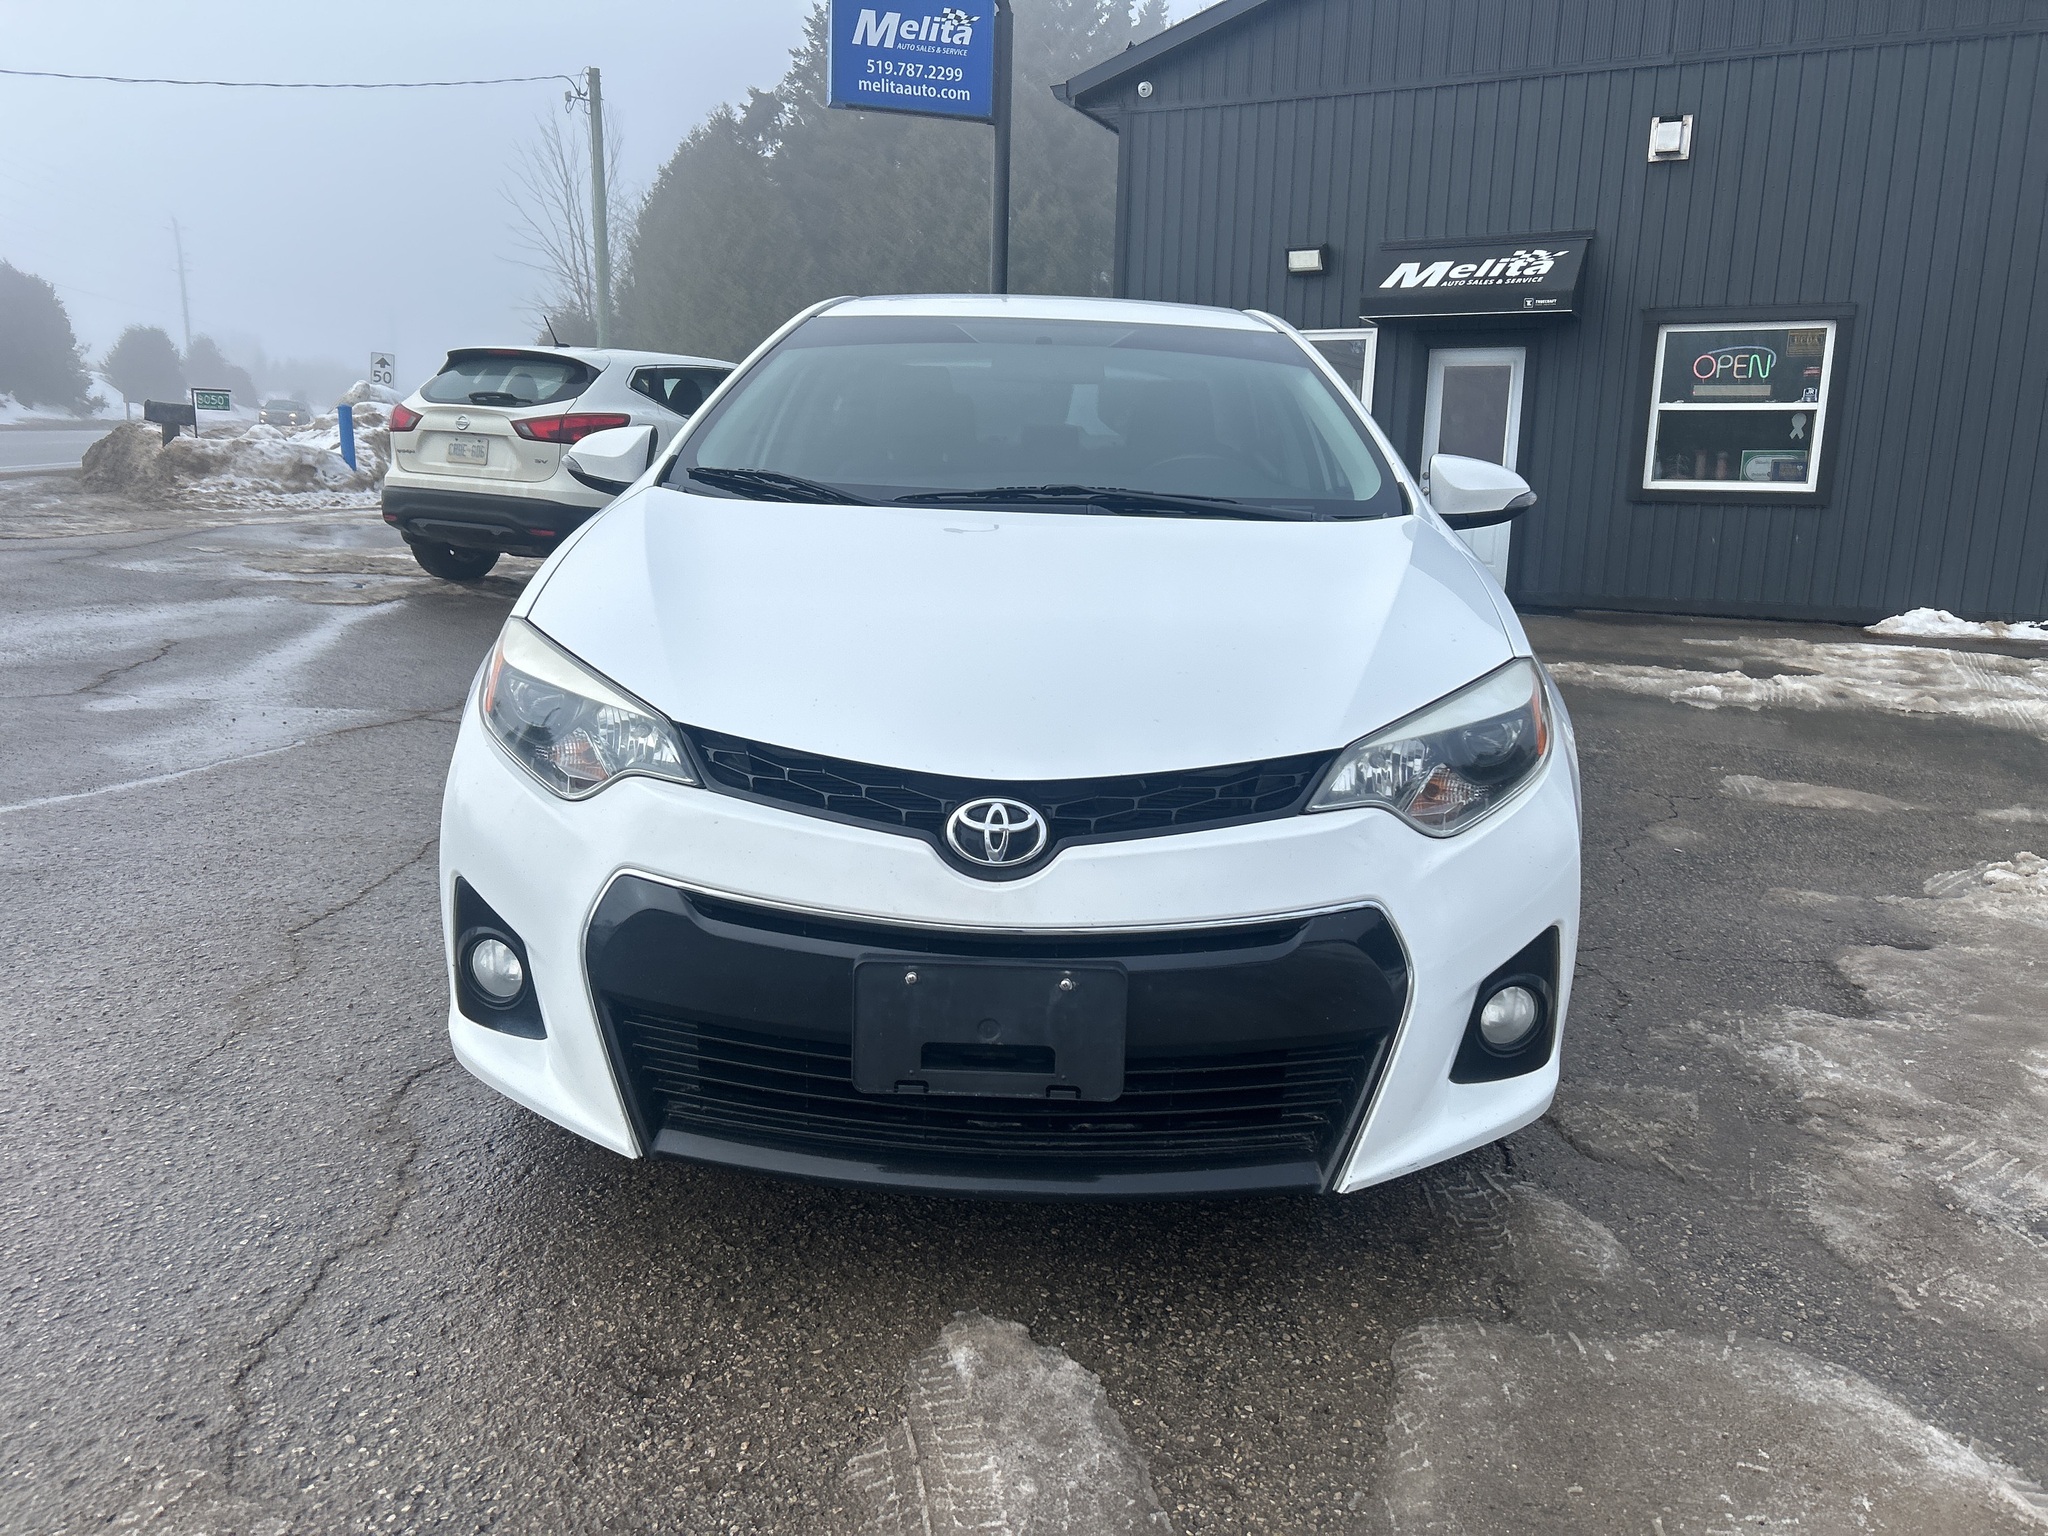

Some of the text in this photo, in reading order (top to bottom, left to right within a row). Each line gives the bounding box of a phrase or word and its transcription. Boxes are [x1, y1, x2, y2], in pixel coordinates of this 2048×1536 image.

[851, 8, 974, 49] Melita
[897, 42, 968, 57] AUTO SALES & SERVICE
[866, 59, 963, 82] 519.787.2299
[858, 78, 971, 101] melitaauto.com
[1379, 257, 1556, 289] Melita
[1466, 278, 1495, 286] SALES
[1504, 276, 1544, 285] SERVICE
[373, 370, 392, 384] 50
[1693, 354, 1772, 379] OPEN
